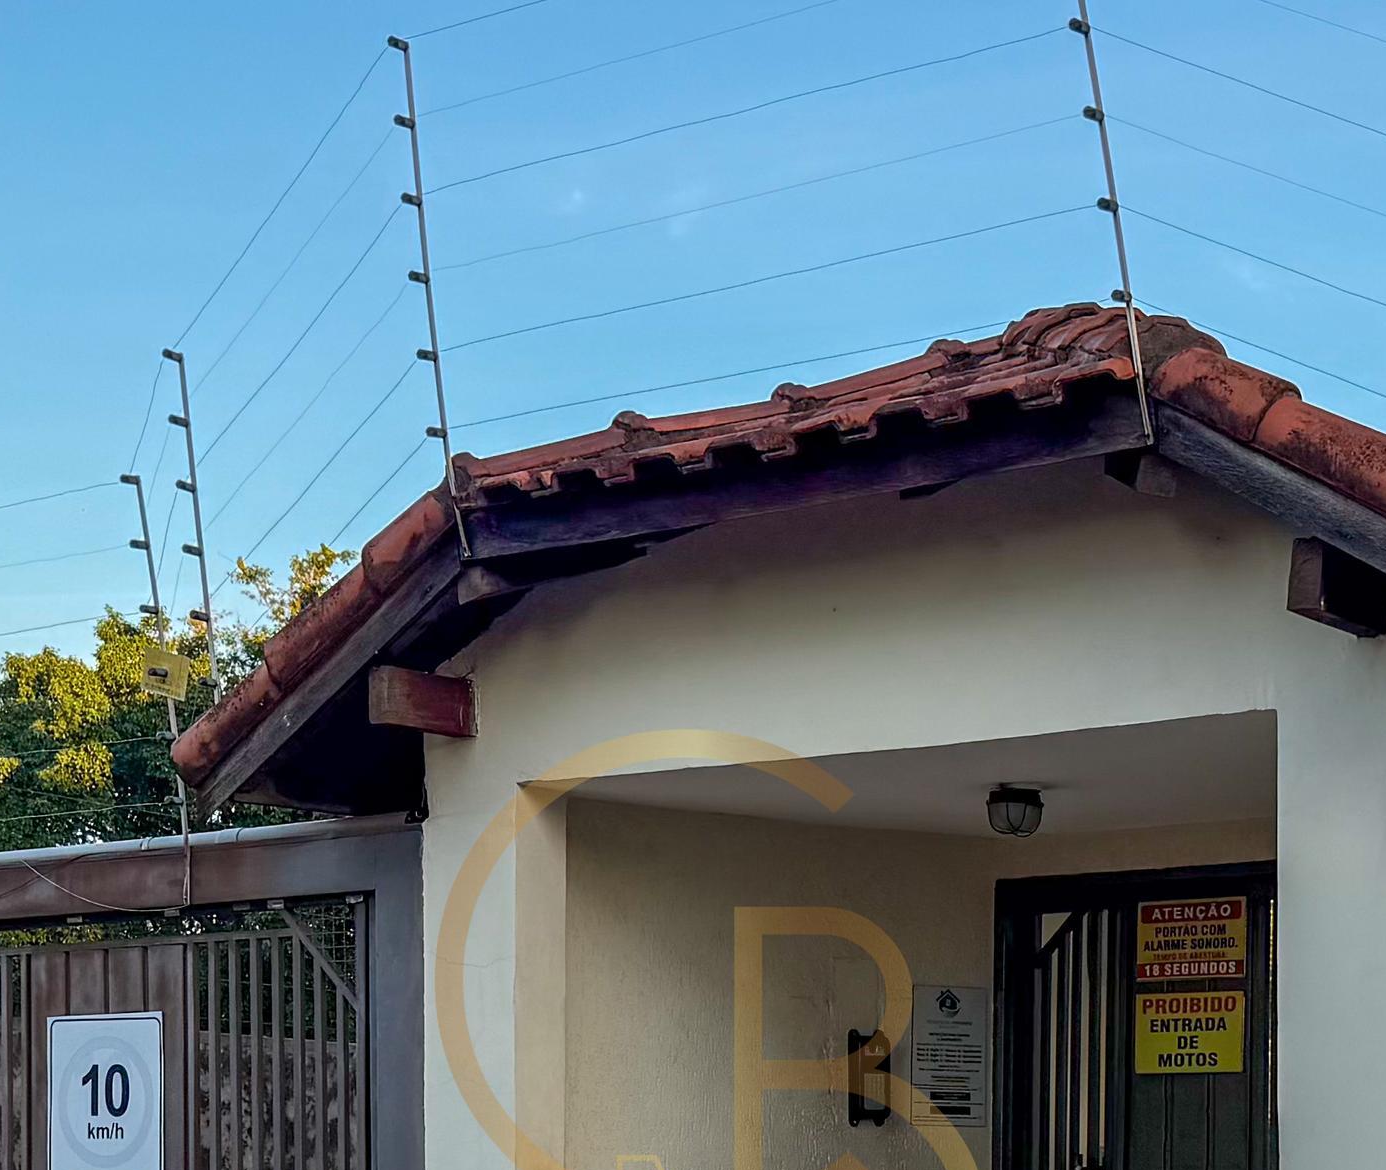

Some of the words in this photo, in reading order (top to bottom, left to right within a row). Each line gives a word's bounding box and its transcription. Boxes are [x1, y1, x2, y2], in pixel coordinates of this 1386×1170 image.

[1152, 903, 1232, 920] ATENÇÃO
[1155, 923, 1198, 938] PORTÃO
[1201, 924, 1227, 935] COM
[1144, 938, 1187, 951] ALARME
[1190, 937, 1238, 949] SONORO.
[1145, 964, 1160, 977] 18
[1164, 961, 1237, 976] SEGUNDOS
[1143, 996, 1237, 1014] PROIBIDO
[1150, 1017, 1227, 1033] ENTRADA
[1177, 1035, 1199, 1050] DE
[1158, 1052, 1218, 1067] MOTOS
[82, 1064, 130, 1118] 10
[87, 1123, 124, 1140] km/h
